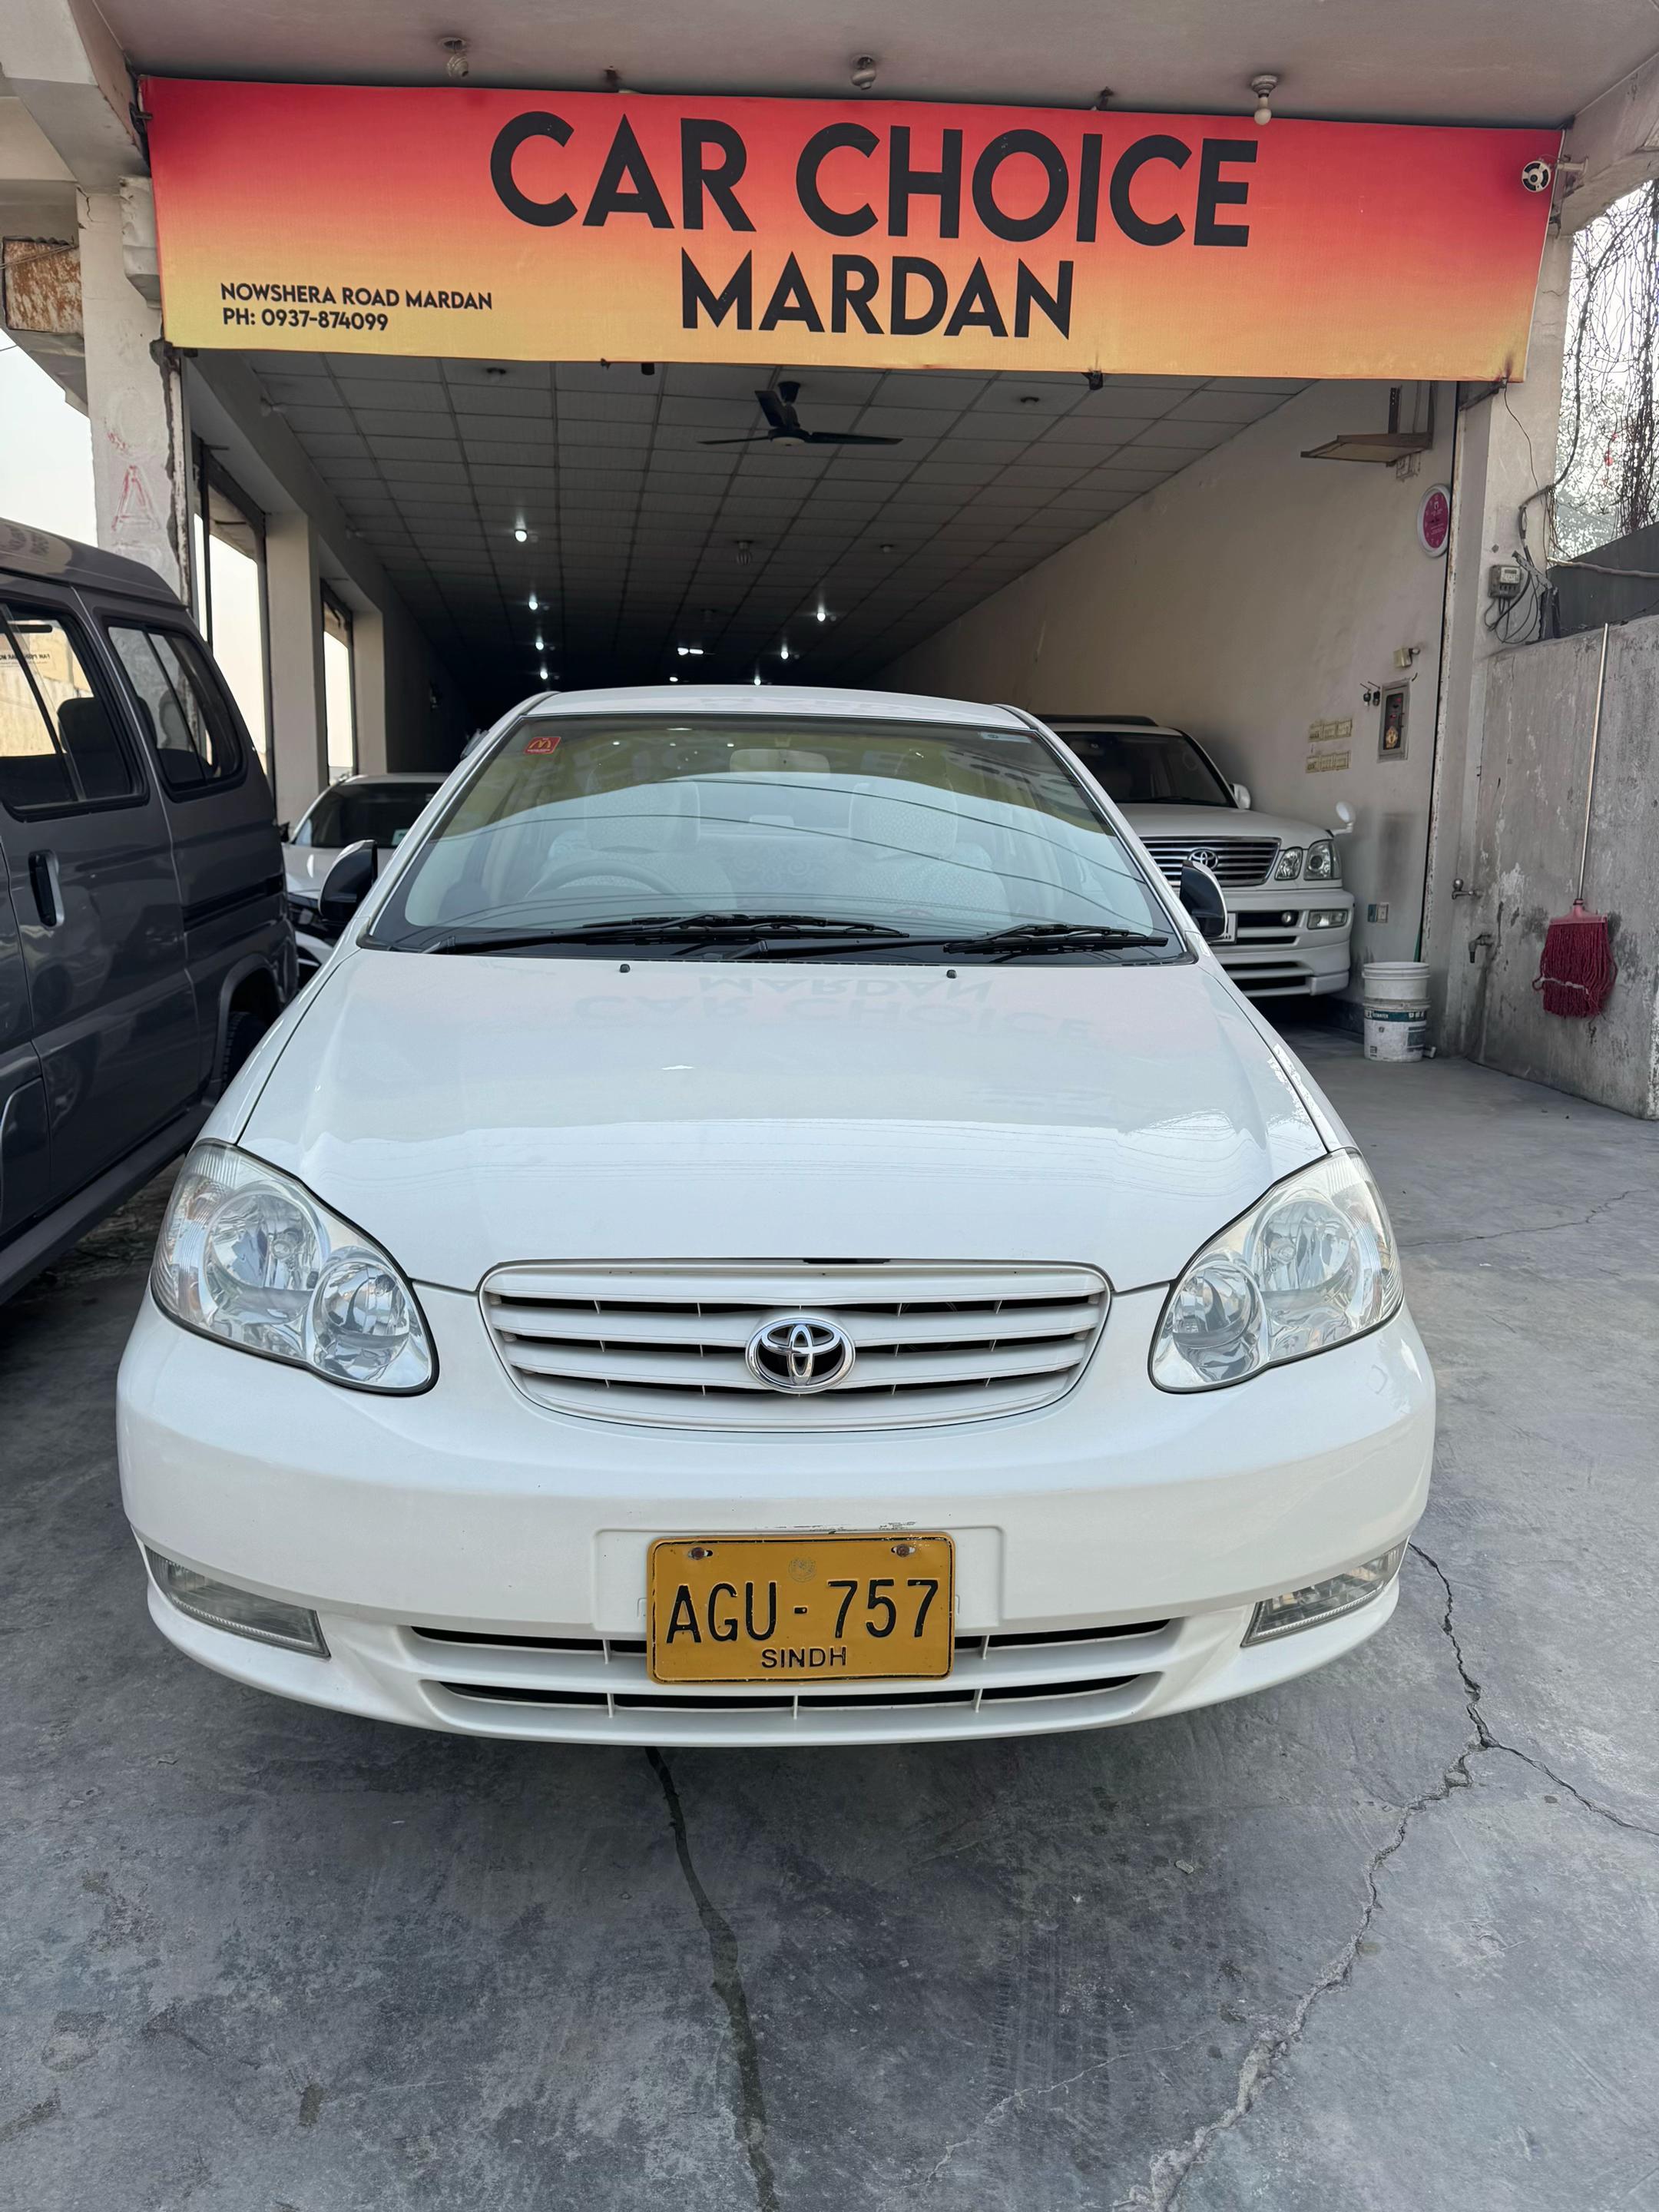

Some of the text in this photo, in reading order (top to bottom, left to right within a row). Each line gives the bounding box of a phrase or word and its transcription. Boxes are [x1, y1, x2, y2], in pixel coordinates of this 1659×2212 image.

[490, 111, 1258, 247] CAR CHOICE
[220, 283, 492, 310] NOWSHERA ROAD MARDAN
[681, 248, 1074, 339] MARDAN
[223, 307, 389, 331] PH: 0937-874099
[665, 1581, 777, 1644] AGU
[827, 1578, 939, 1638] 757
[760, 1646, 847, 1669] SINDH
